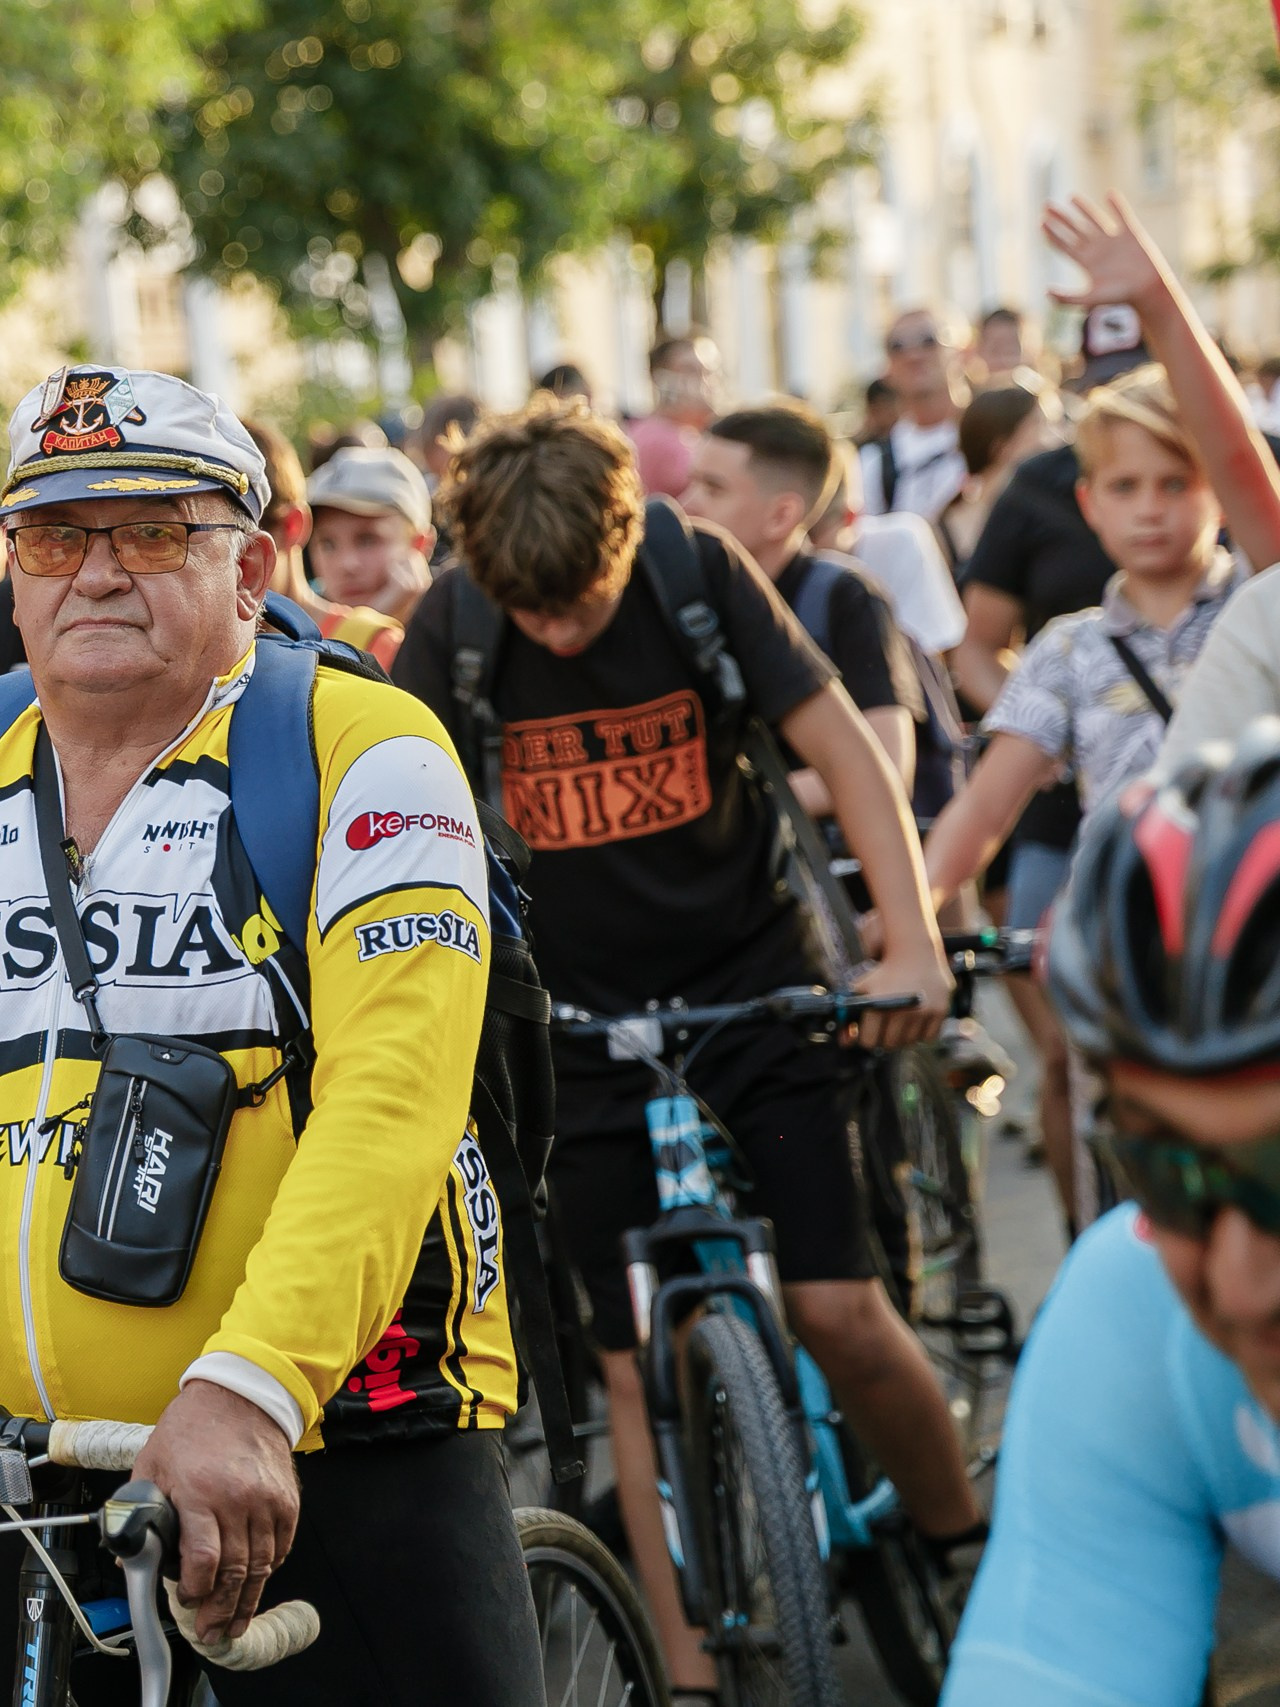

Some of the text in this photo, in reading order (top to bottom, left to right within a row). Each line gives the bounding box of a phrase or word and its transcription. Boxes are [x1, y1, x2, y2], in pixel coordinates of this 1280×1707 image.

[54, 430, 107, 450] КАПИТАН
[593, 701, 692, 759] TUT
[356, 910, 482, 964] RUSSIA
[138, 1127, 173, 1214] HARI
[455, 1133, 499, 1314] SSIA
